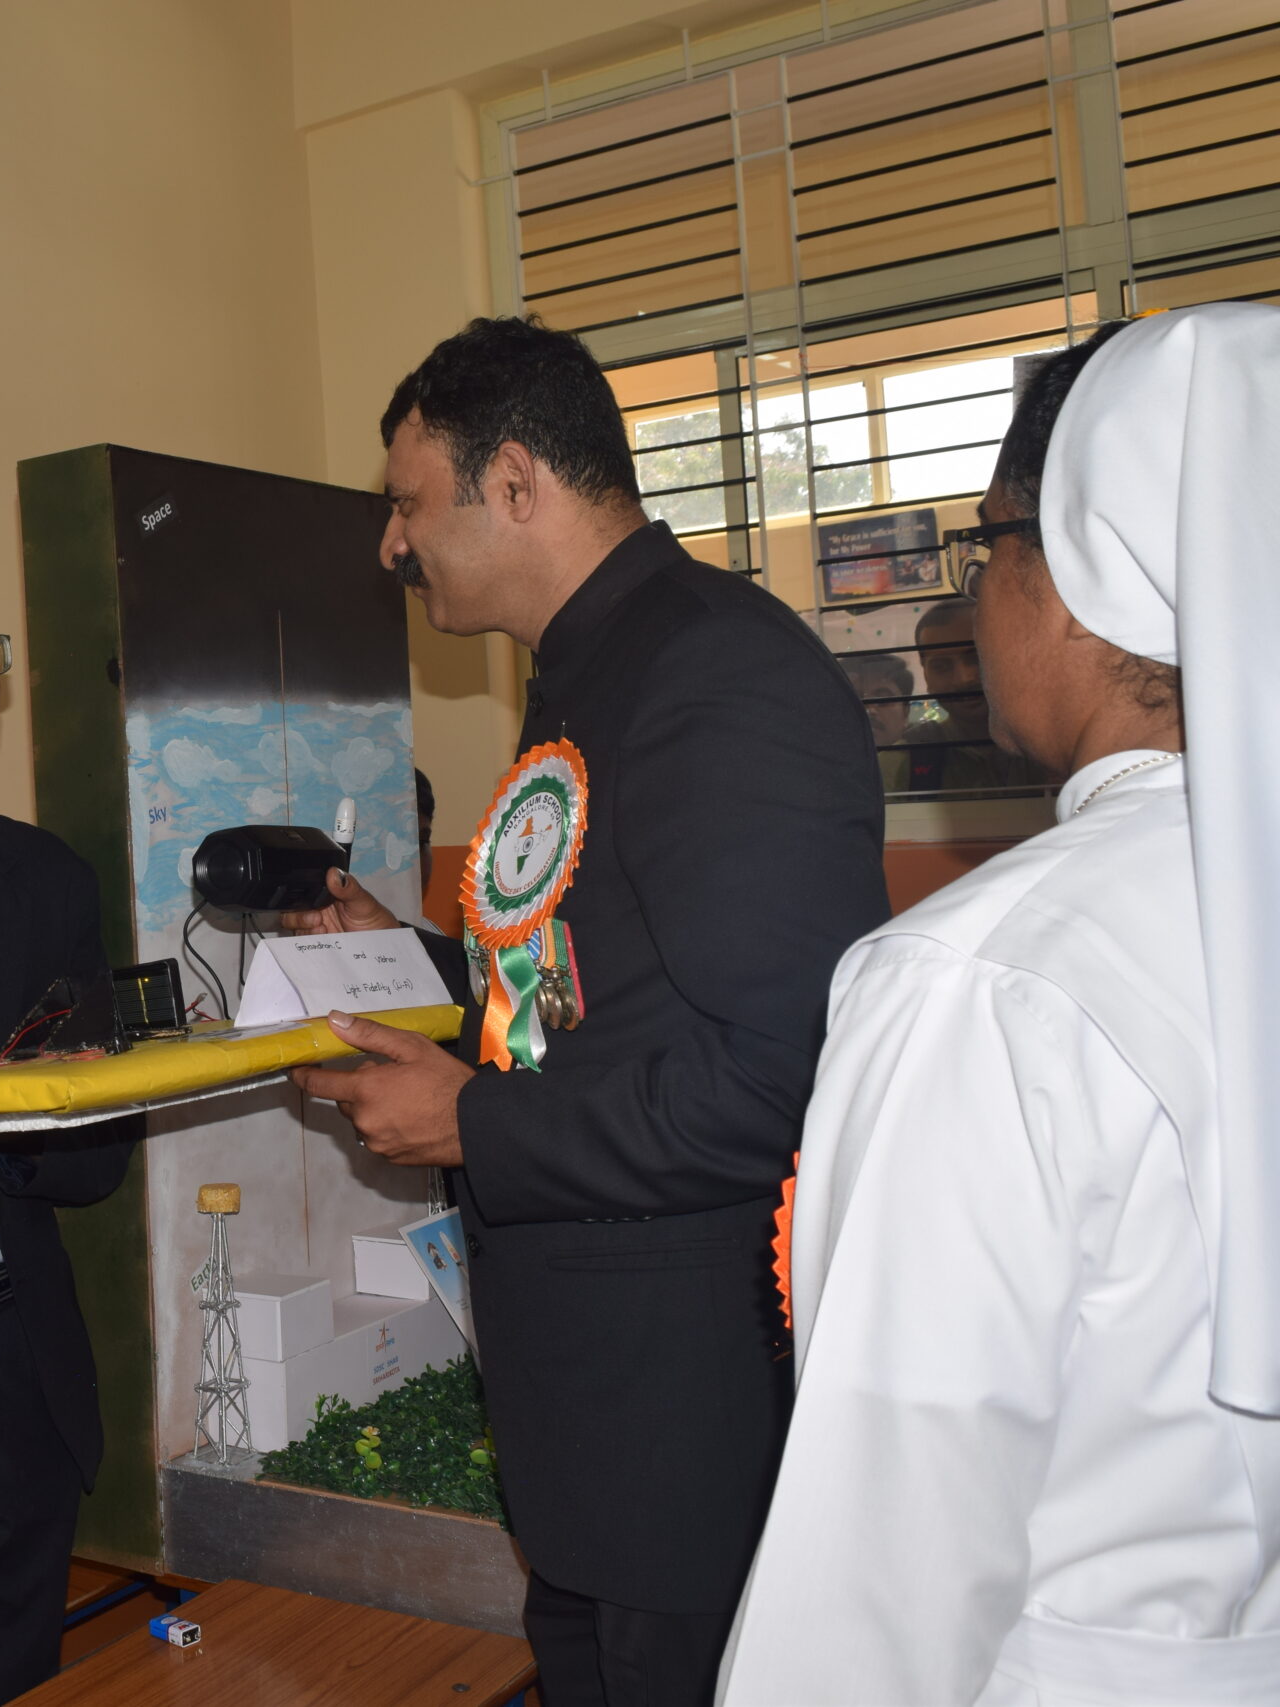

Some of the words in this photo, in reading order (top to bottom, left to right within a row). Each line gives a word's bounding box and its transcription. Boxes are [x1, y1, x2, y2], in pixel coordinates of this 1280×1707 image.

[141, 503, 172, 531] Space
[842, 532, 861, 542] Grace
[851, 543, 872, 553] Power
[503, 794, 542, 838] AUXILIUM
[542, 794, 562, 829] SCHOOL
[514, 804, 549, 830] BANGALORE
[523, 847, 557, 890] CELEBRATION
[353, 951, 367, 960] and
[343, 983, 361, 999] Light
[363, 981, 391, 996] Fidelity
